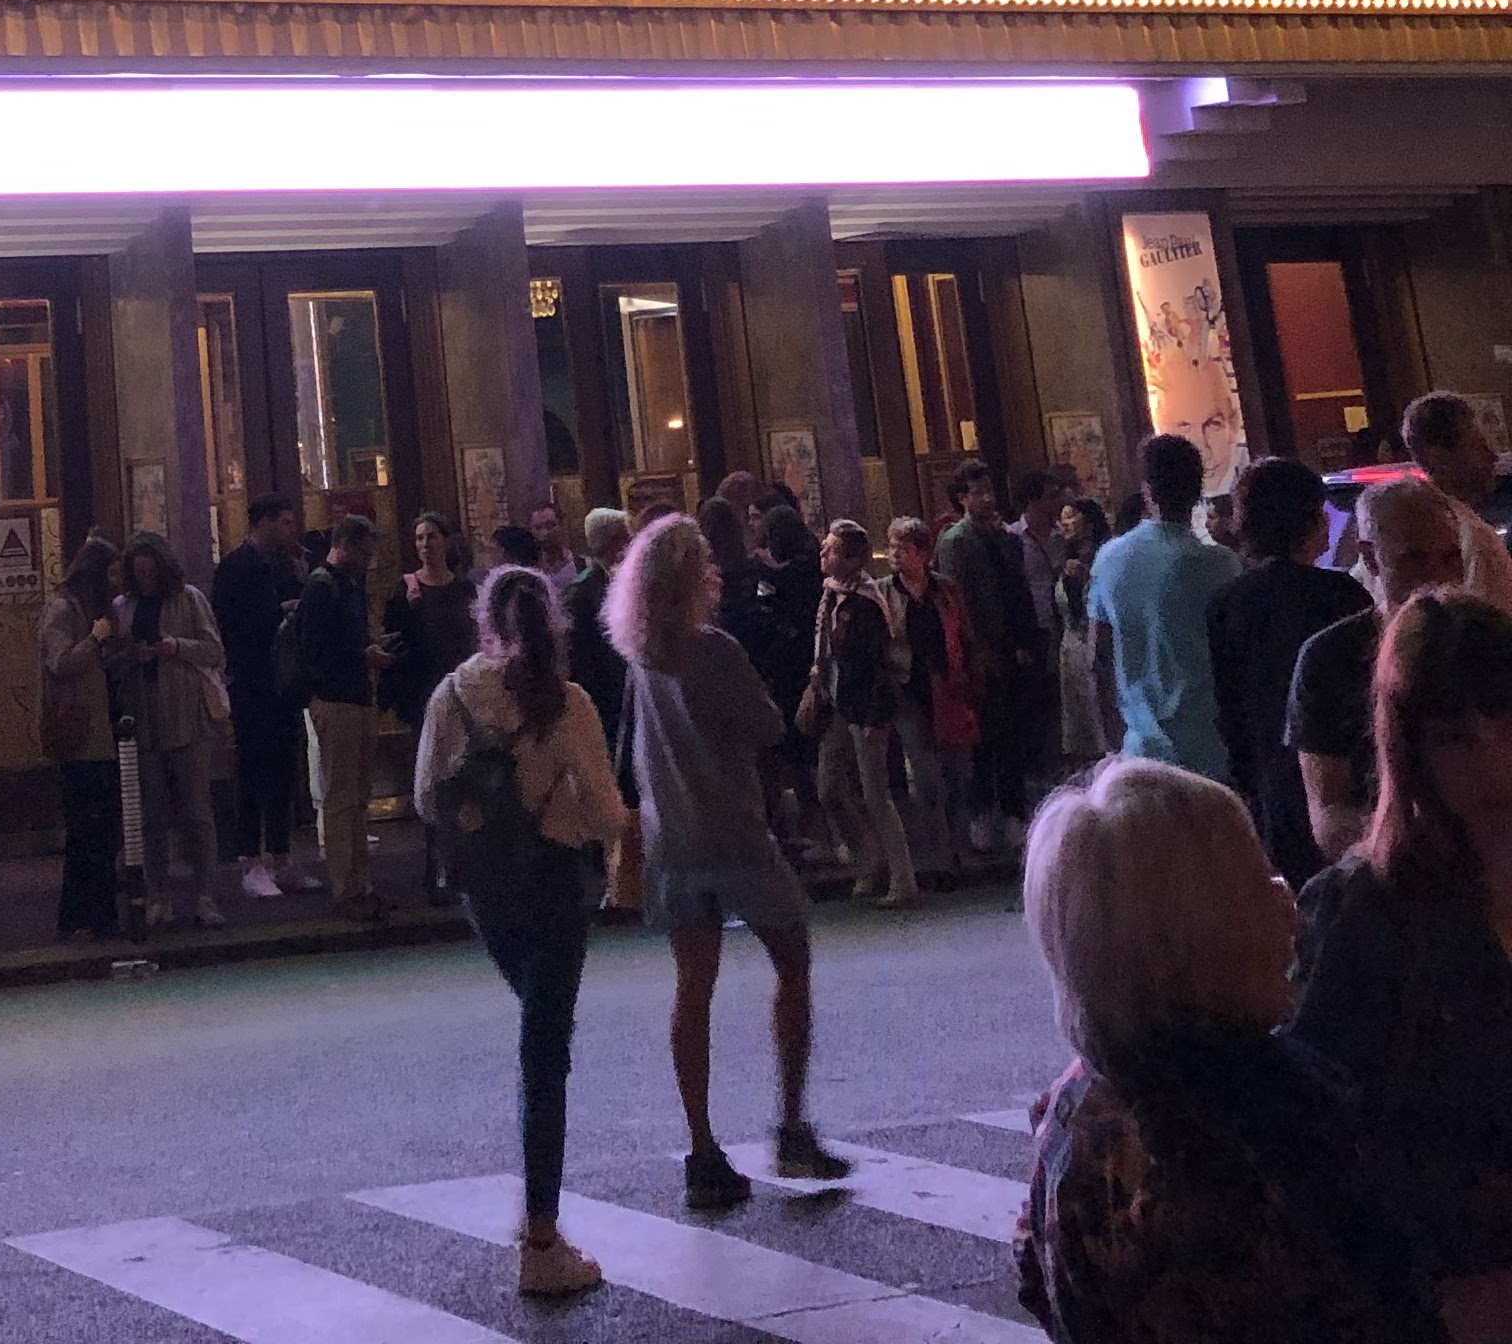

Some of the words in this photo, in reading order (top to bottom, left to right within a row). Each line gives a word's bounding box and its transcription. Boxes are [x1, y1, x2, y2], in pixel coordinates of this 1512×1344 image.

[1141, 232, 1168, 249] Jean
[1169, 232, 1196, 249] Paul
[1139, 242, 1203, 268] GAULTIER
